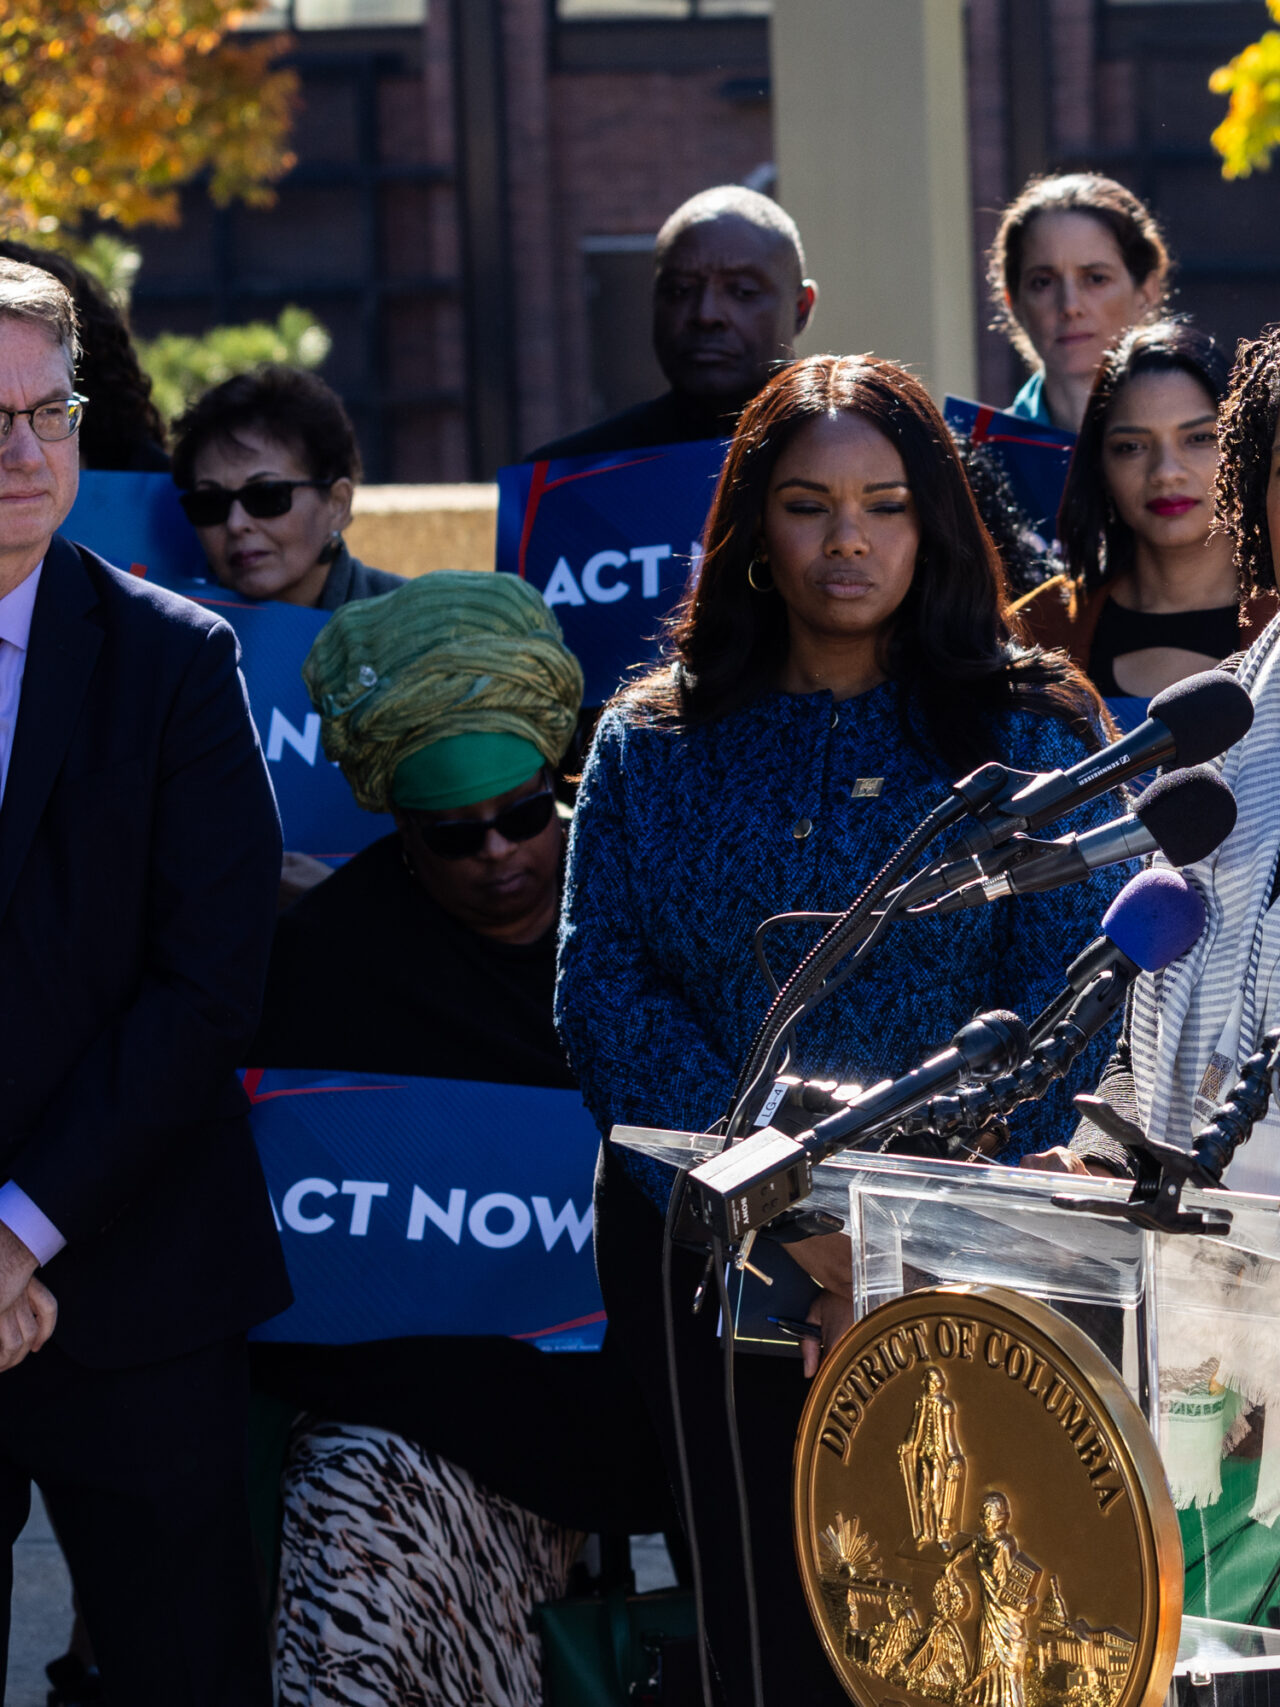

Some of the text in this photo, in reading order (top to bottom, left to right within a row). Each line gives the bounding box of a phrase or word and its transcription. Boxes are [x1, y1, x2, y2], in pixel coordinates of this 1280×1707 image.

[542, 543, 671, 609] ACT
[1078, 760, 1120, 786] SENNHEISER
[761, 1089, 784, 1118] LG-4
[268, 1177, 595, 1255] CT NOW
[740, 1196, 750, 1226] SONY
[820, 1317, 1127, 1518] DISTRICT OF COLUMBIA
